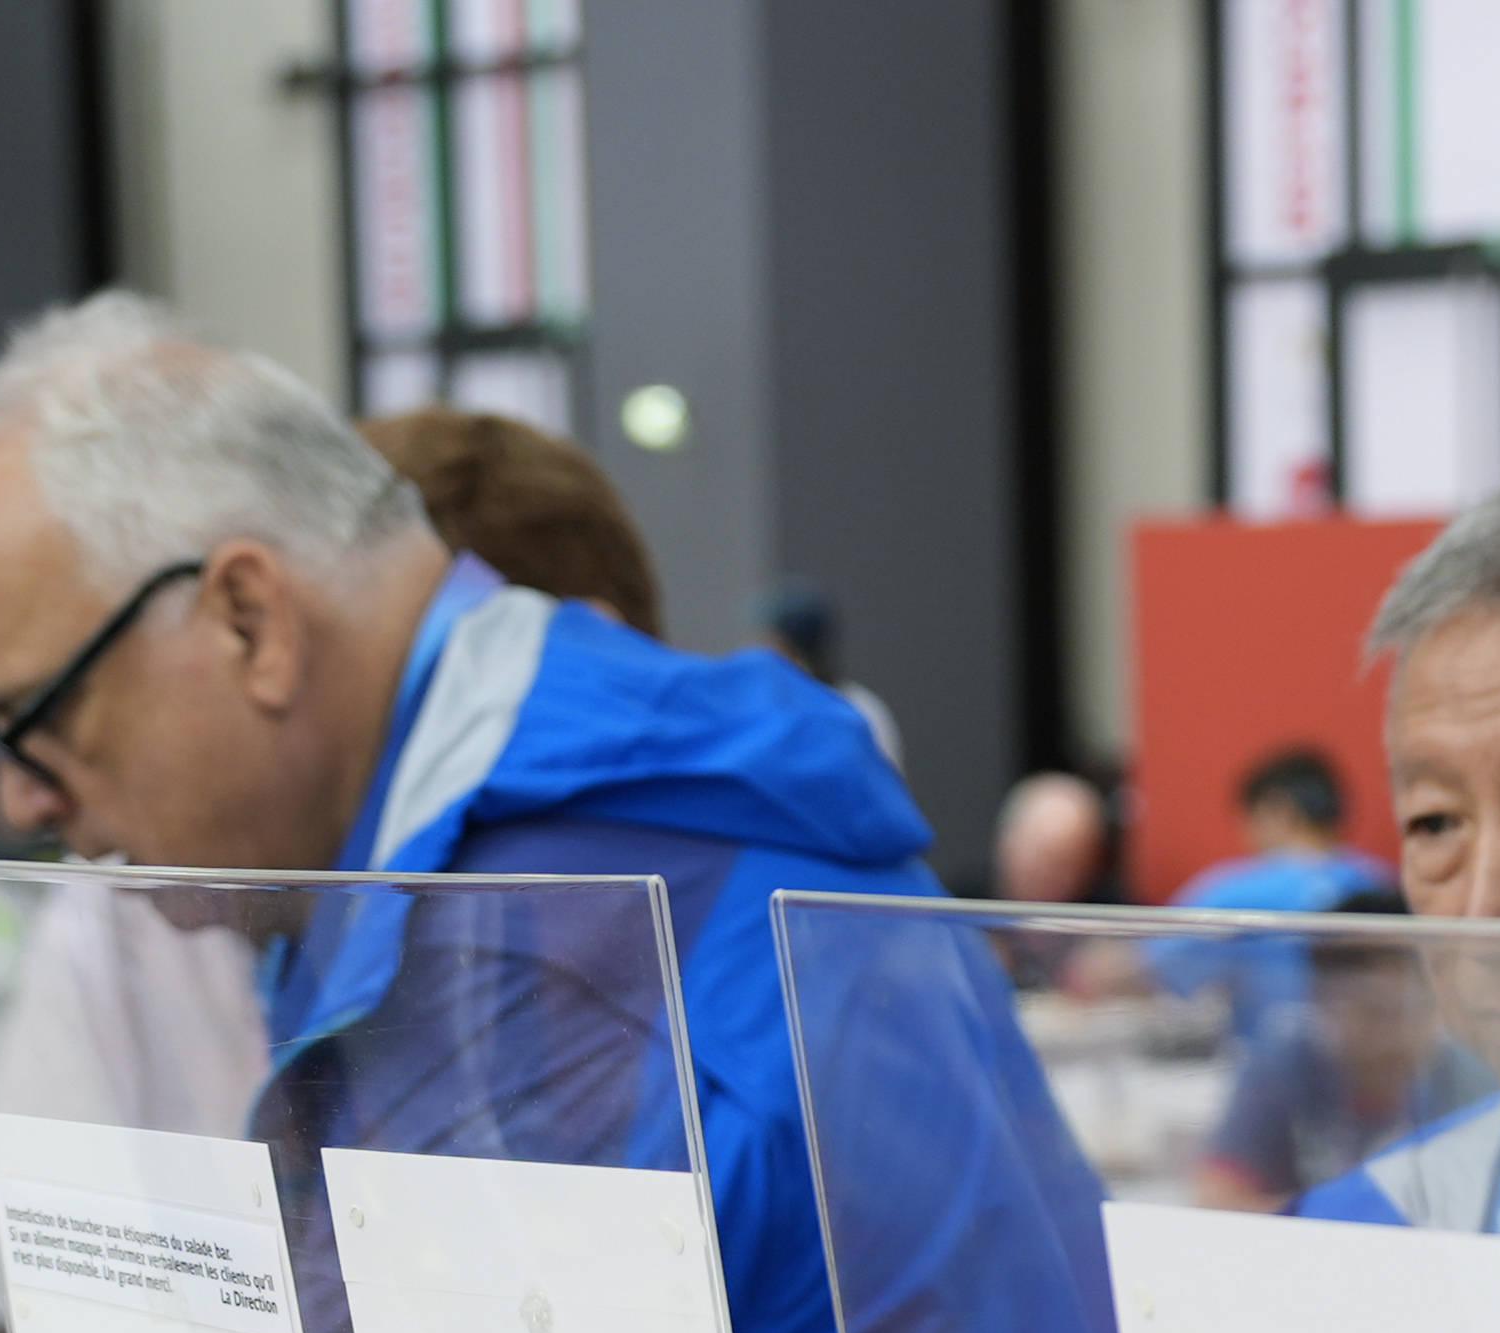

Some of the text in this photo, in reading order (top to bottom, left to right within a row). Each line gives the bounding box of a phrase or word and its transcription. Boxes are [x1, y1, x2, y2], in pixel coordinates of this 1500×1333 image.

[5, 1205, 55, 1227] Interdiction
[57, 1213, 68, 1231] de
[69, 1216, 103, 1236] toucher
[105, 1225, 121, 1240] aux
[123, 1223, 169, 1249] étiquettes
[170, 1233, 182, 1251] du
[184, 1238, 213, 1258] salade
[8, 1226, 18, 1242] Si
[20, 1231, 32, 1244] un
[34, 1230, 67, 1251] aliment
[105, 1243, 146, 1266] informez
[148, 1252, 204, 1279] verbalement
[204, 1262, 219, 1281] les
[220, 1265, 251, 1288] clients
[36, 1253, 54, 1272] plus
[103, 1264, 116, 1282] Un
[117, 1271, 144, 1289] grand
[220, 1287, 278, 1315] La Direction
